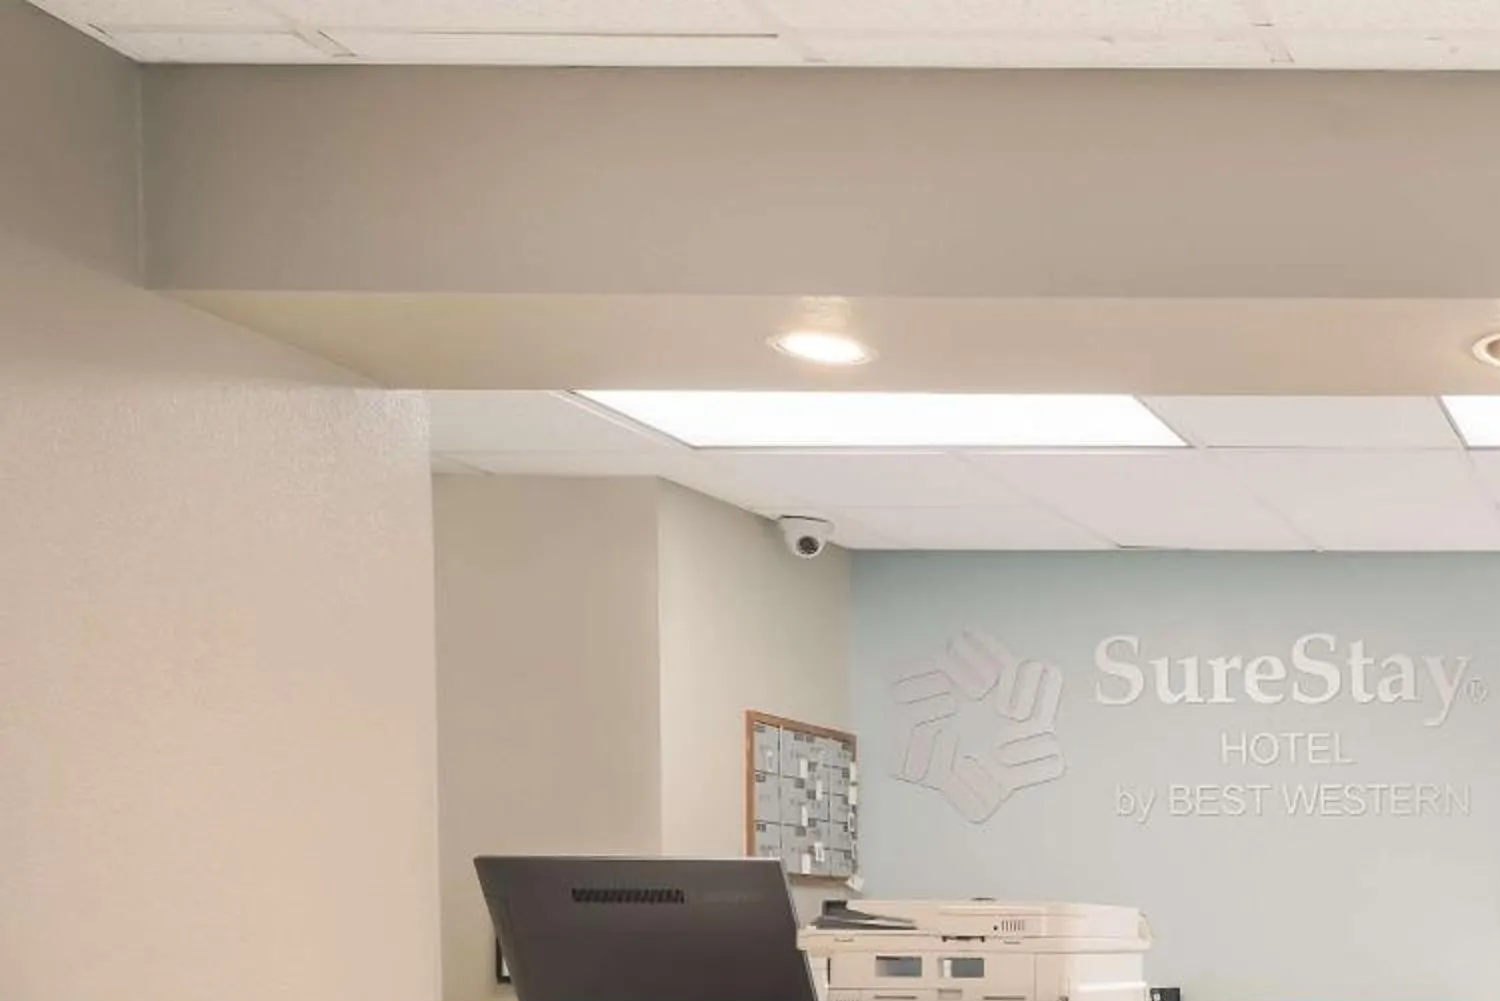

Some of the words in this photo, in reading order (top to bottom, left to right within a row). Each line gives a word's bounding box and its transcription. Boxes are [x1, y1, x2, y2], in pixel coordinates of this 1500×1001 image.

[1220, 732, 1357, 766] HOTEL
[1116, 784, 1155, 823] by
[1169, 783, 1272, 817] BEST
[1282, 782, 1473, 816] WESTERN
